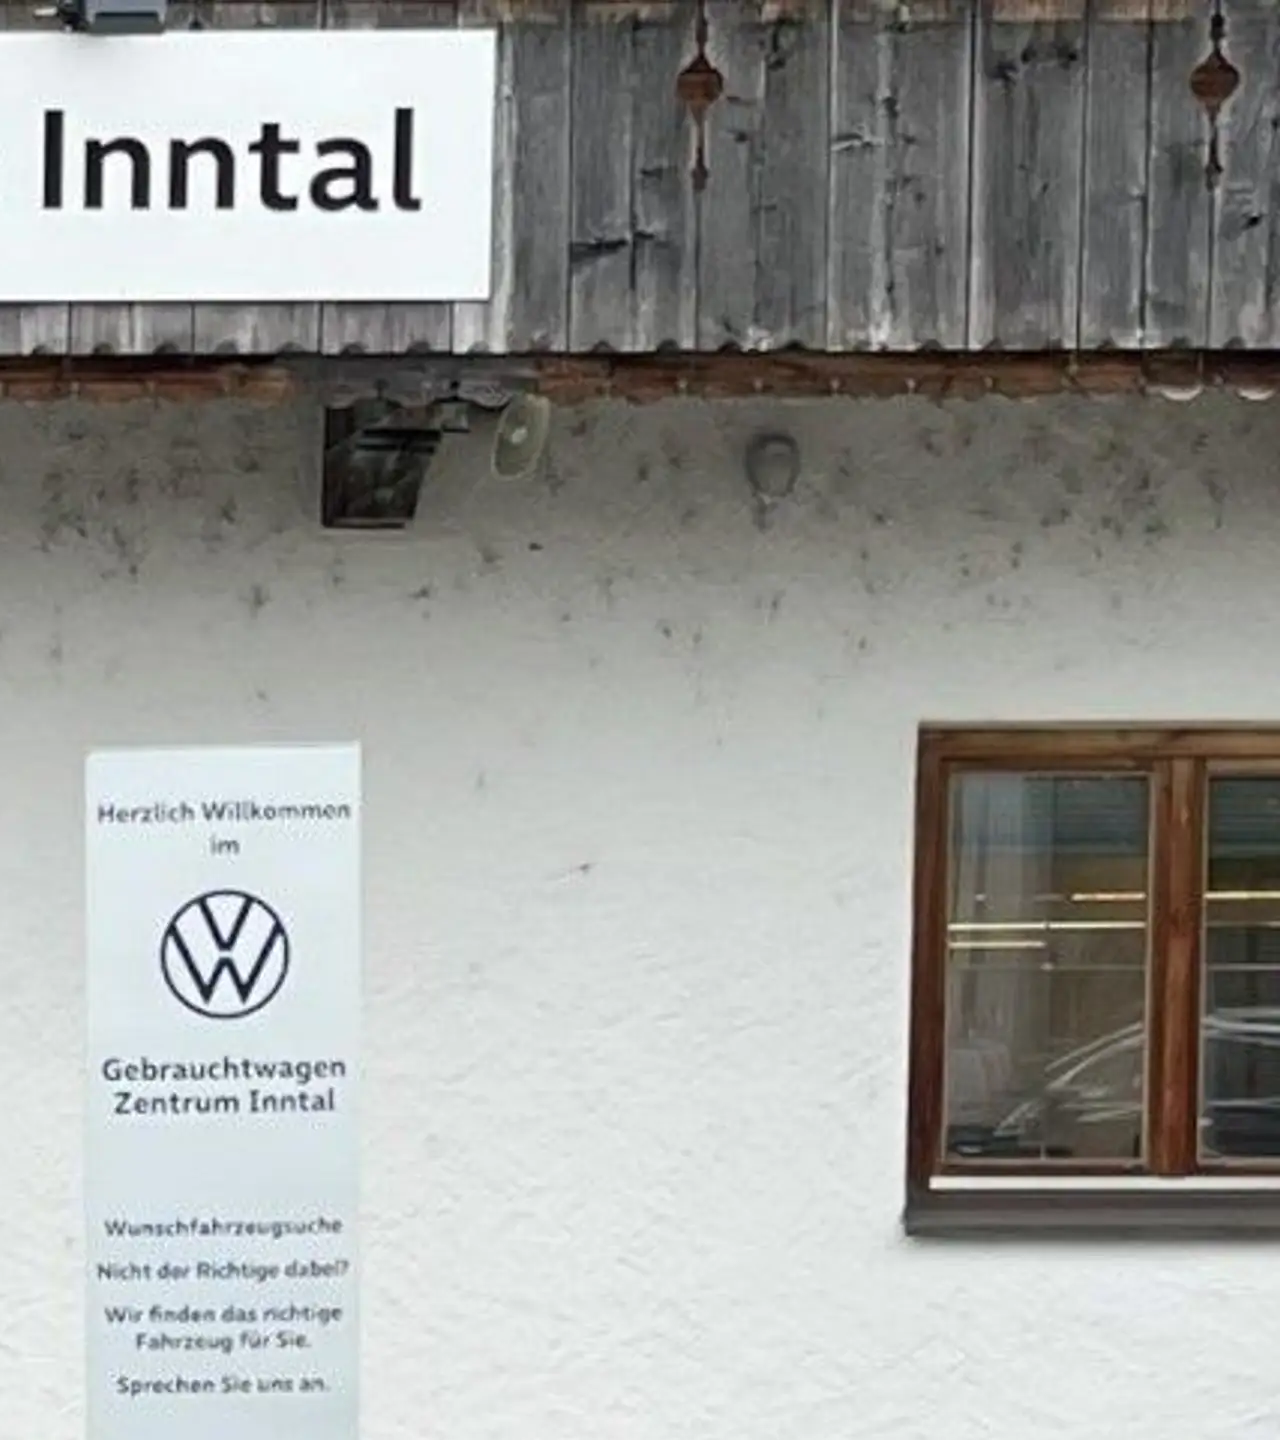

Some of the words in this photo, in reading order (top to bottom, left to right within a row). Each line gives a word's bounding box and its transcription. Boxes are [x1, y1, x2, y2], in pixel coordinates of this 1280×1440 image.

[42, 107, 422, 213] Inntal
[98, 802, 195, 823] Herzlich
[201, 800, 351, 821] Willkommen
[210, 835, 241, 855] im
[101, 1055, 346, 1085] Gebrauchtwagen
[114, 1090, 240, 1115] Zentrum
[249, 1087, 336, 1114] Inntal
[104, 1216, 344, 1239] Wunschfahrzeugsuche
[97, 1262, 151, 1281] Nicht
[156, 1262, 190, 1281] der
[196, 1260, 280, 1284] Richtige
[104, 1306, 143, 1323] Wir
[148, 1305, 216, 1323] finden
[221, 1304, 257, 1323] das
[263, 1303, 344, 1326] richtige
[136, 1332, 235, 1355] Fahrzeug
[240, 1331, 270, 1350] für
[116, 1375, 215, 1397] Sprechen
[220, 1375, 253, 1394] Sie
[256, 1377, 294, 1394] uns
